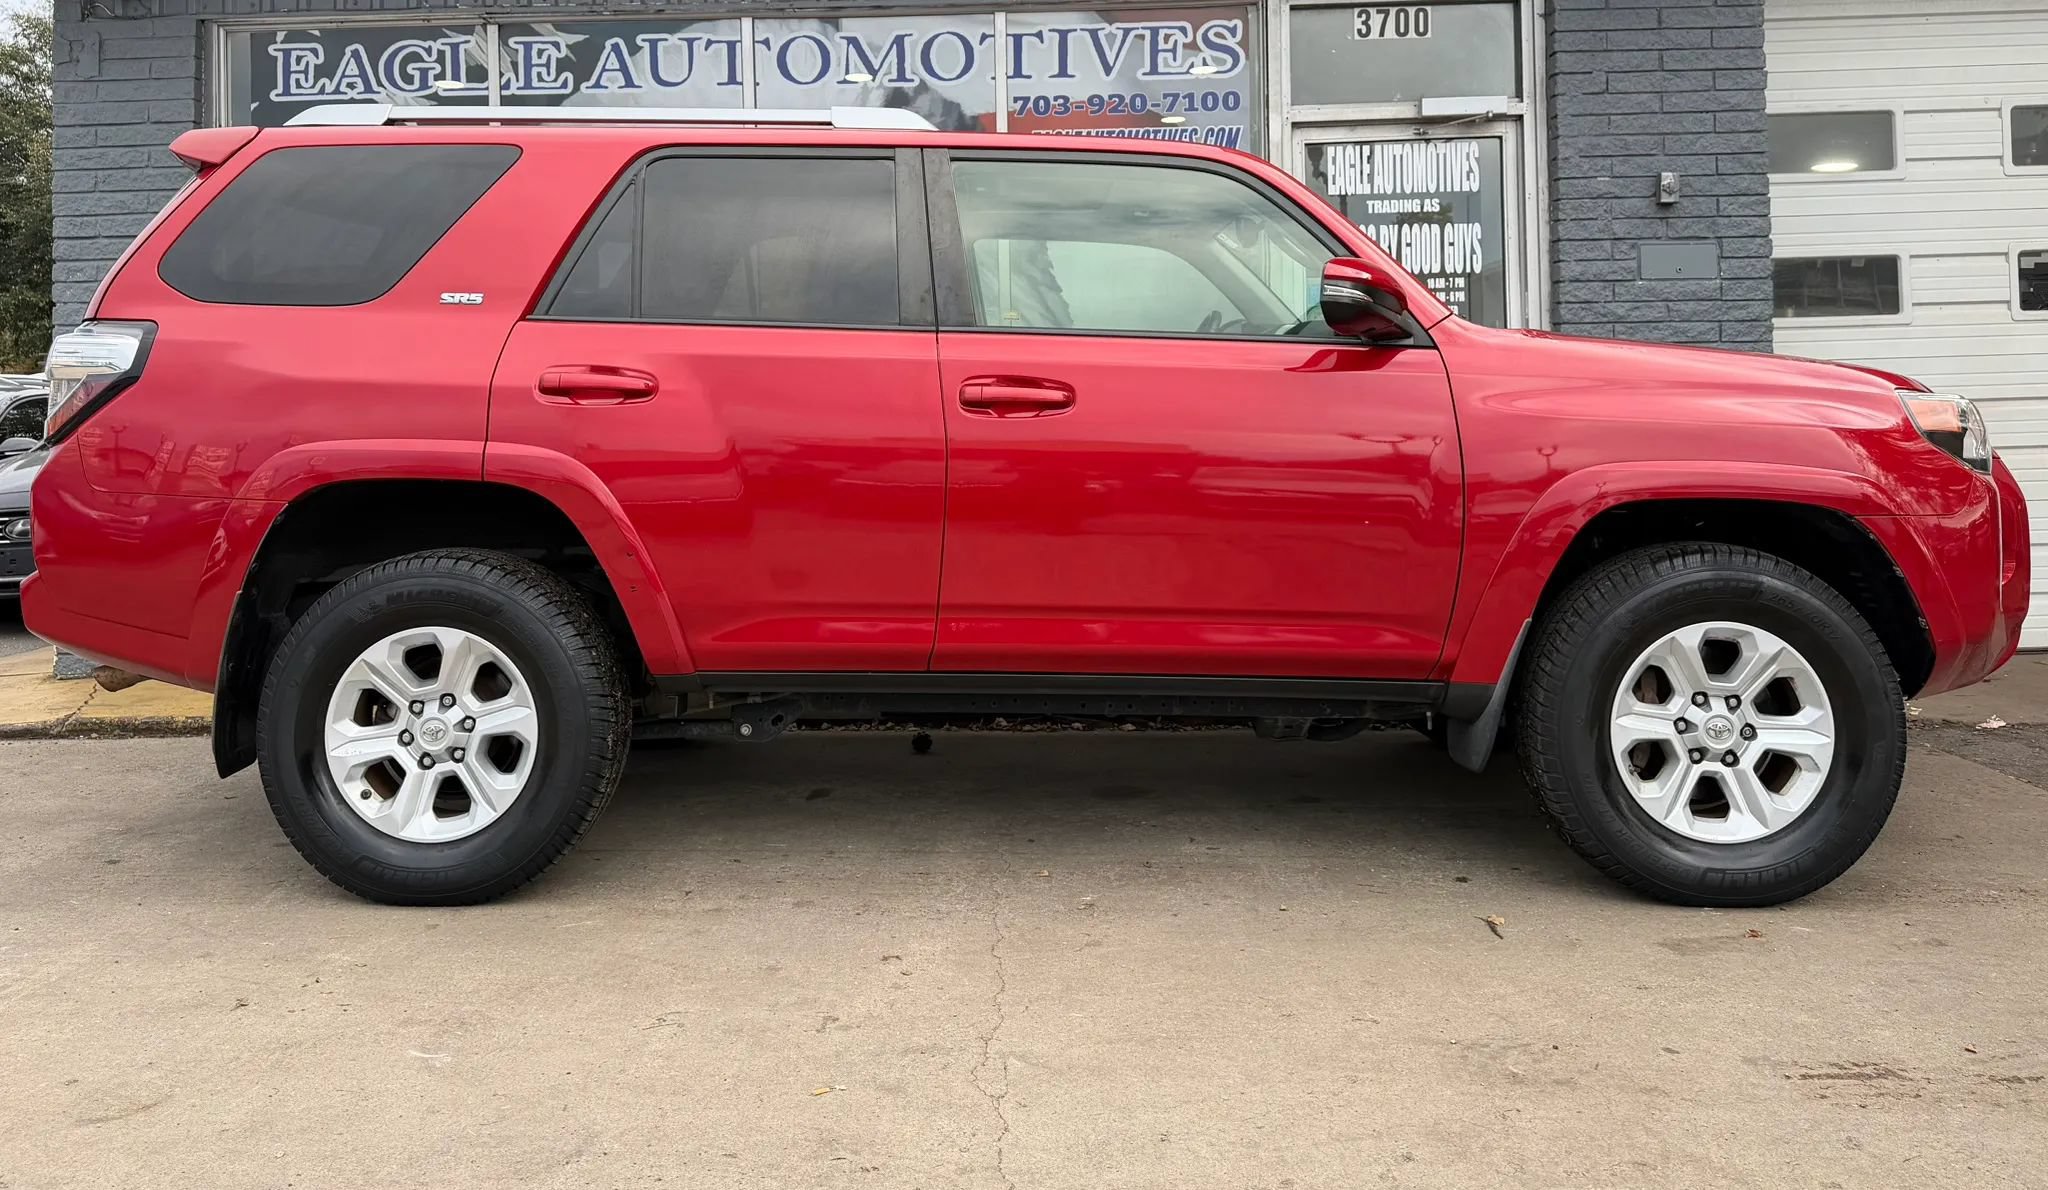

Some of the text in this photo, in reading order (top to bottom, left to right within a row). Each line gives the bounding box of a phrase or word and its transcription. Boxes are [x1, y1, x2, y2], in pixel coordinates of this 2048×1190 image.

[1356, 7, 1429, 38] 3700
[268, 19, 1246, 101] EAGLE AUTOMOTIVES
[1012, 90, 1242, 117] 703-920-7100
[1326, 141, 1480, 195] EAGLE AUTOMOTIVES
[1366, 198, 1440, 214] TRADING AS
[1401, 223, 1442, 274] GOOD
[1444, 222, 1482, 274] GUYS
[1455, 277, 1465, 288] PM
[439, 292, 485, 305] SR5
[1455, 291, 1465, 302] PM
